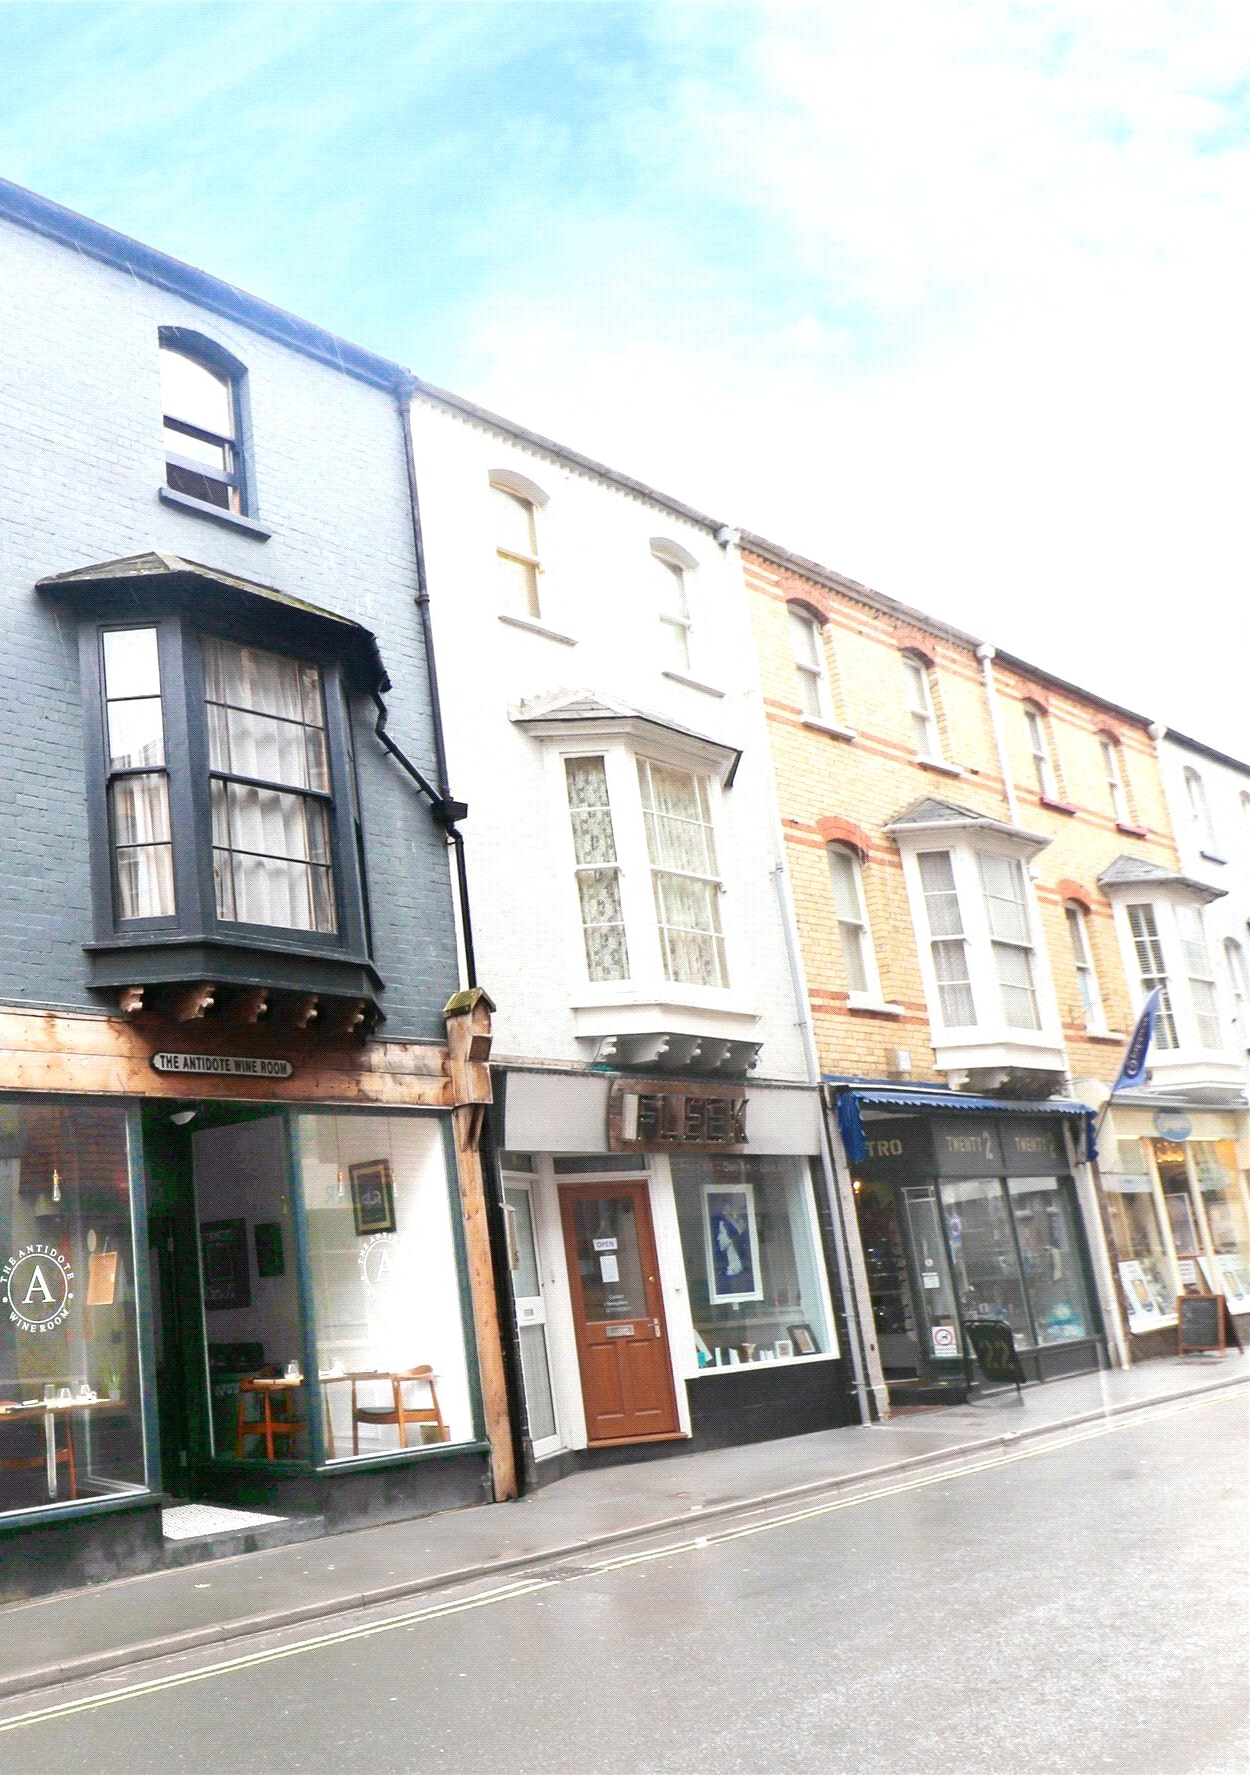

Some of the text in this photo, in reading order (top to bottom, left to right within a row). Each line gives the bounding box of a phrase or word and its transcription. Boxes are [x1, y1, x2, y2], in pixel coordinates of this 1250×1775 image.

[159, 1055, 287, 1075] THE ANTIDOTE WINE ROOM
[596, 1240, 615, 1249] OPEN
[18, 1244, 75, 1280] ANTIDOTE
[21, 1264, 56, 1304] A
[9, 1308, 69, 1333] WINE ROOM
